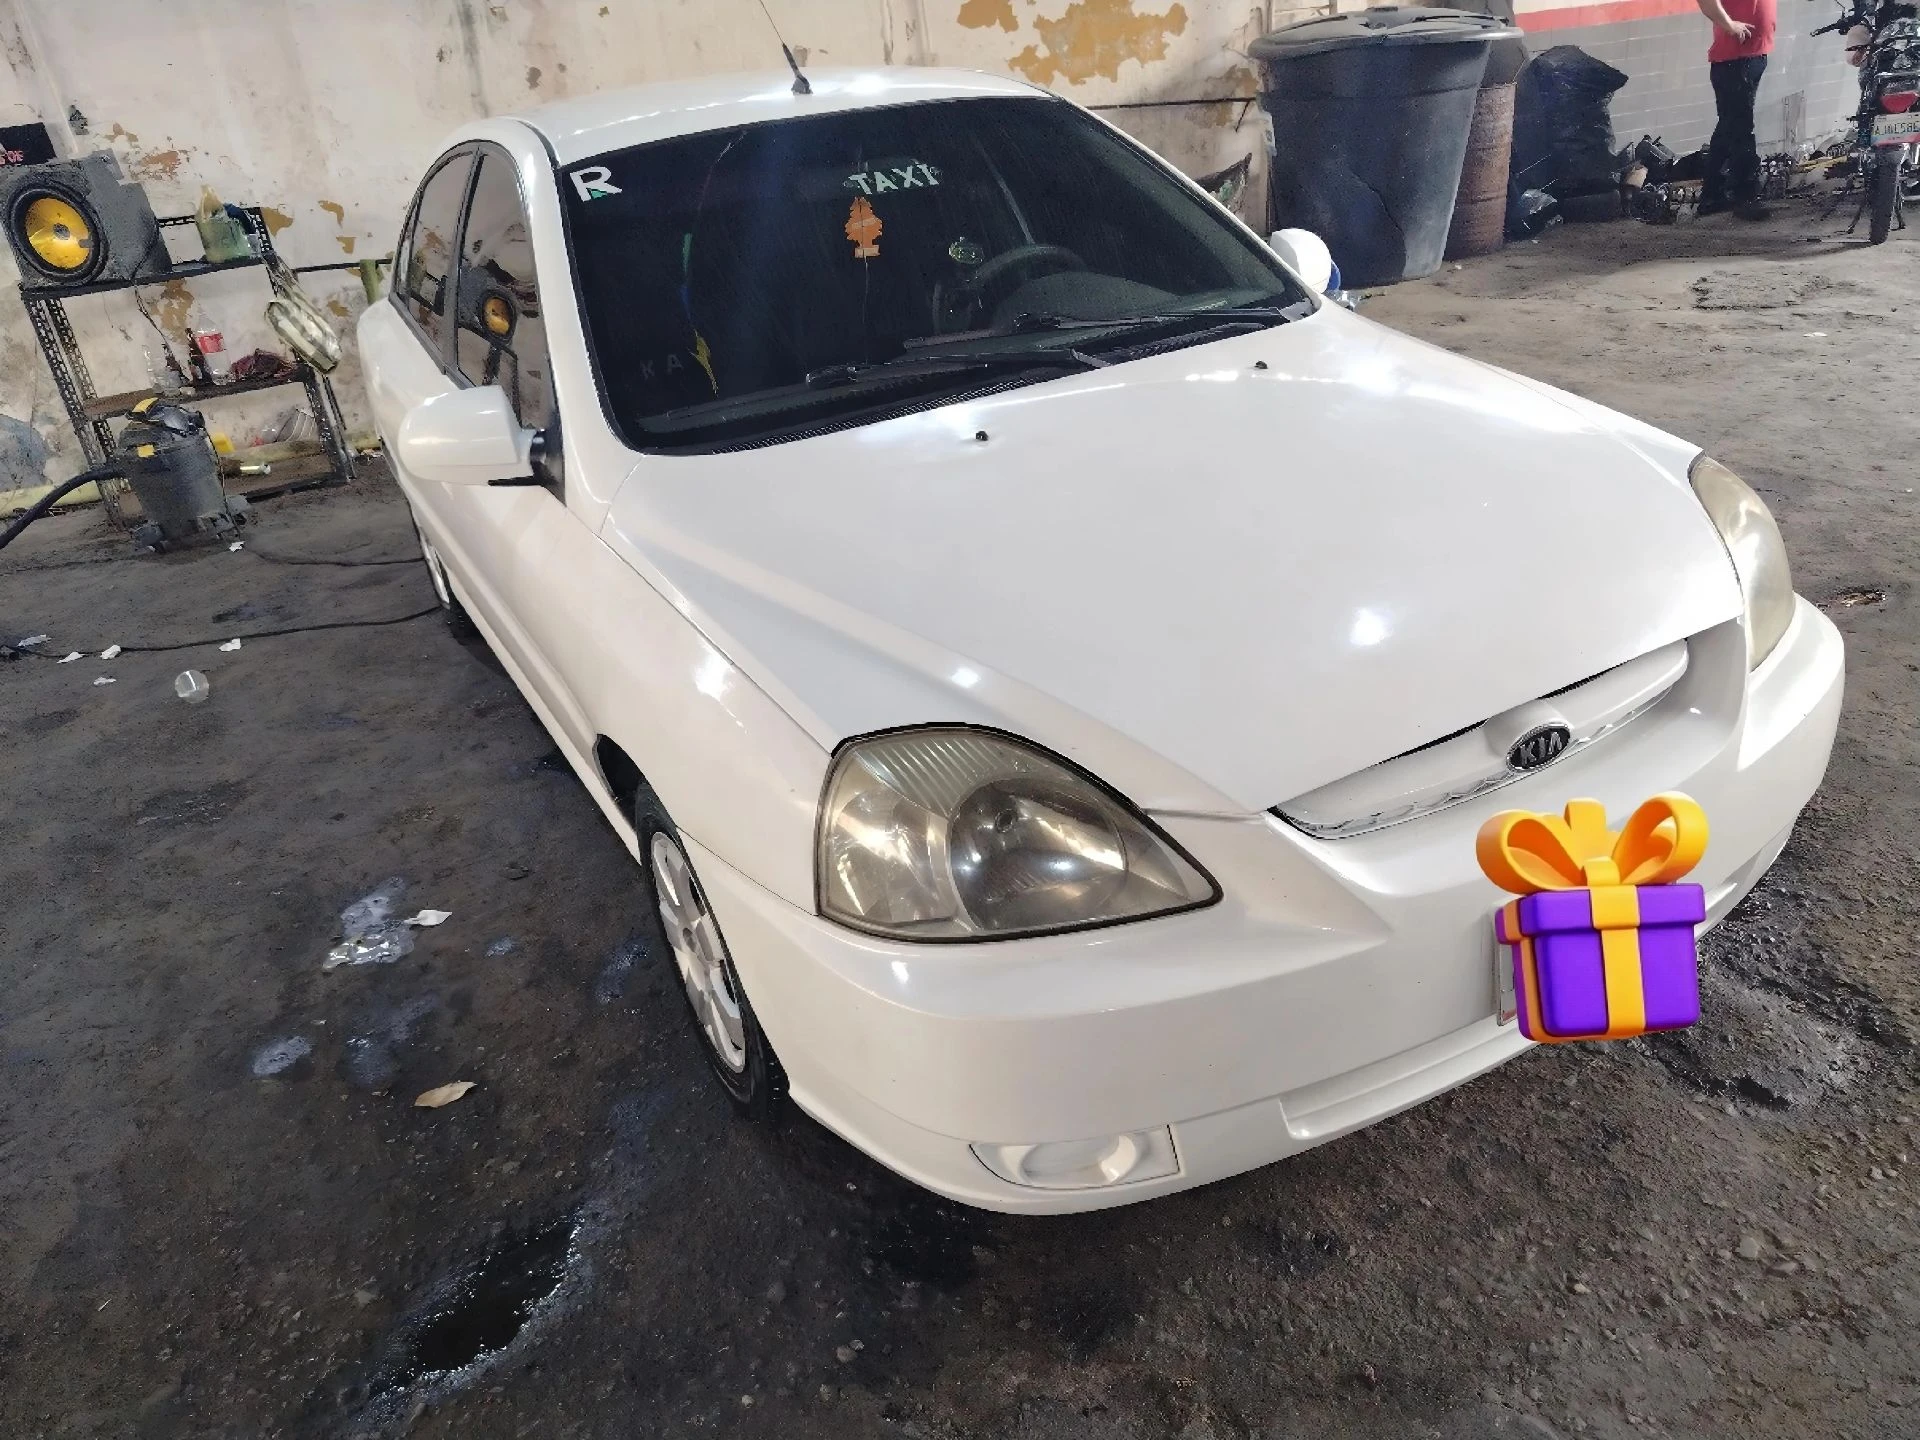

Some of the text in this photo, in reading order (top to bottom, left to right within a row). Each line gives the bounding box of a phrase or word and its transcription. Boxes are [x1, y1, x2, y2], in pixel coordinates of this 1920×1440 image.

[569, 166, 623, 202] R
[848, 163, 939, 195] TAXI
[1520, 731, 1562, 766] KIA
